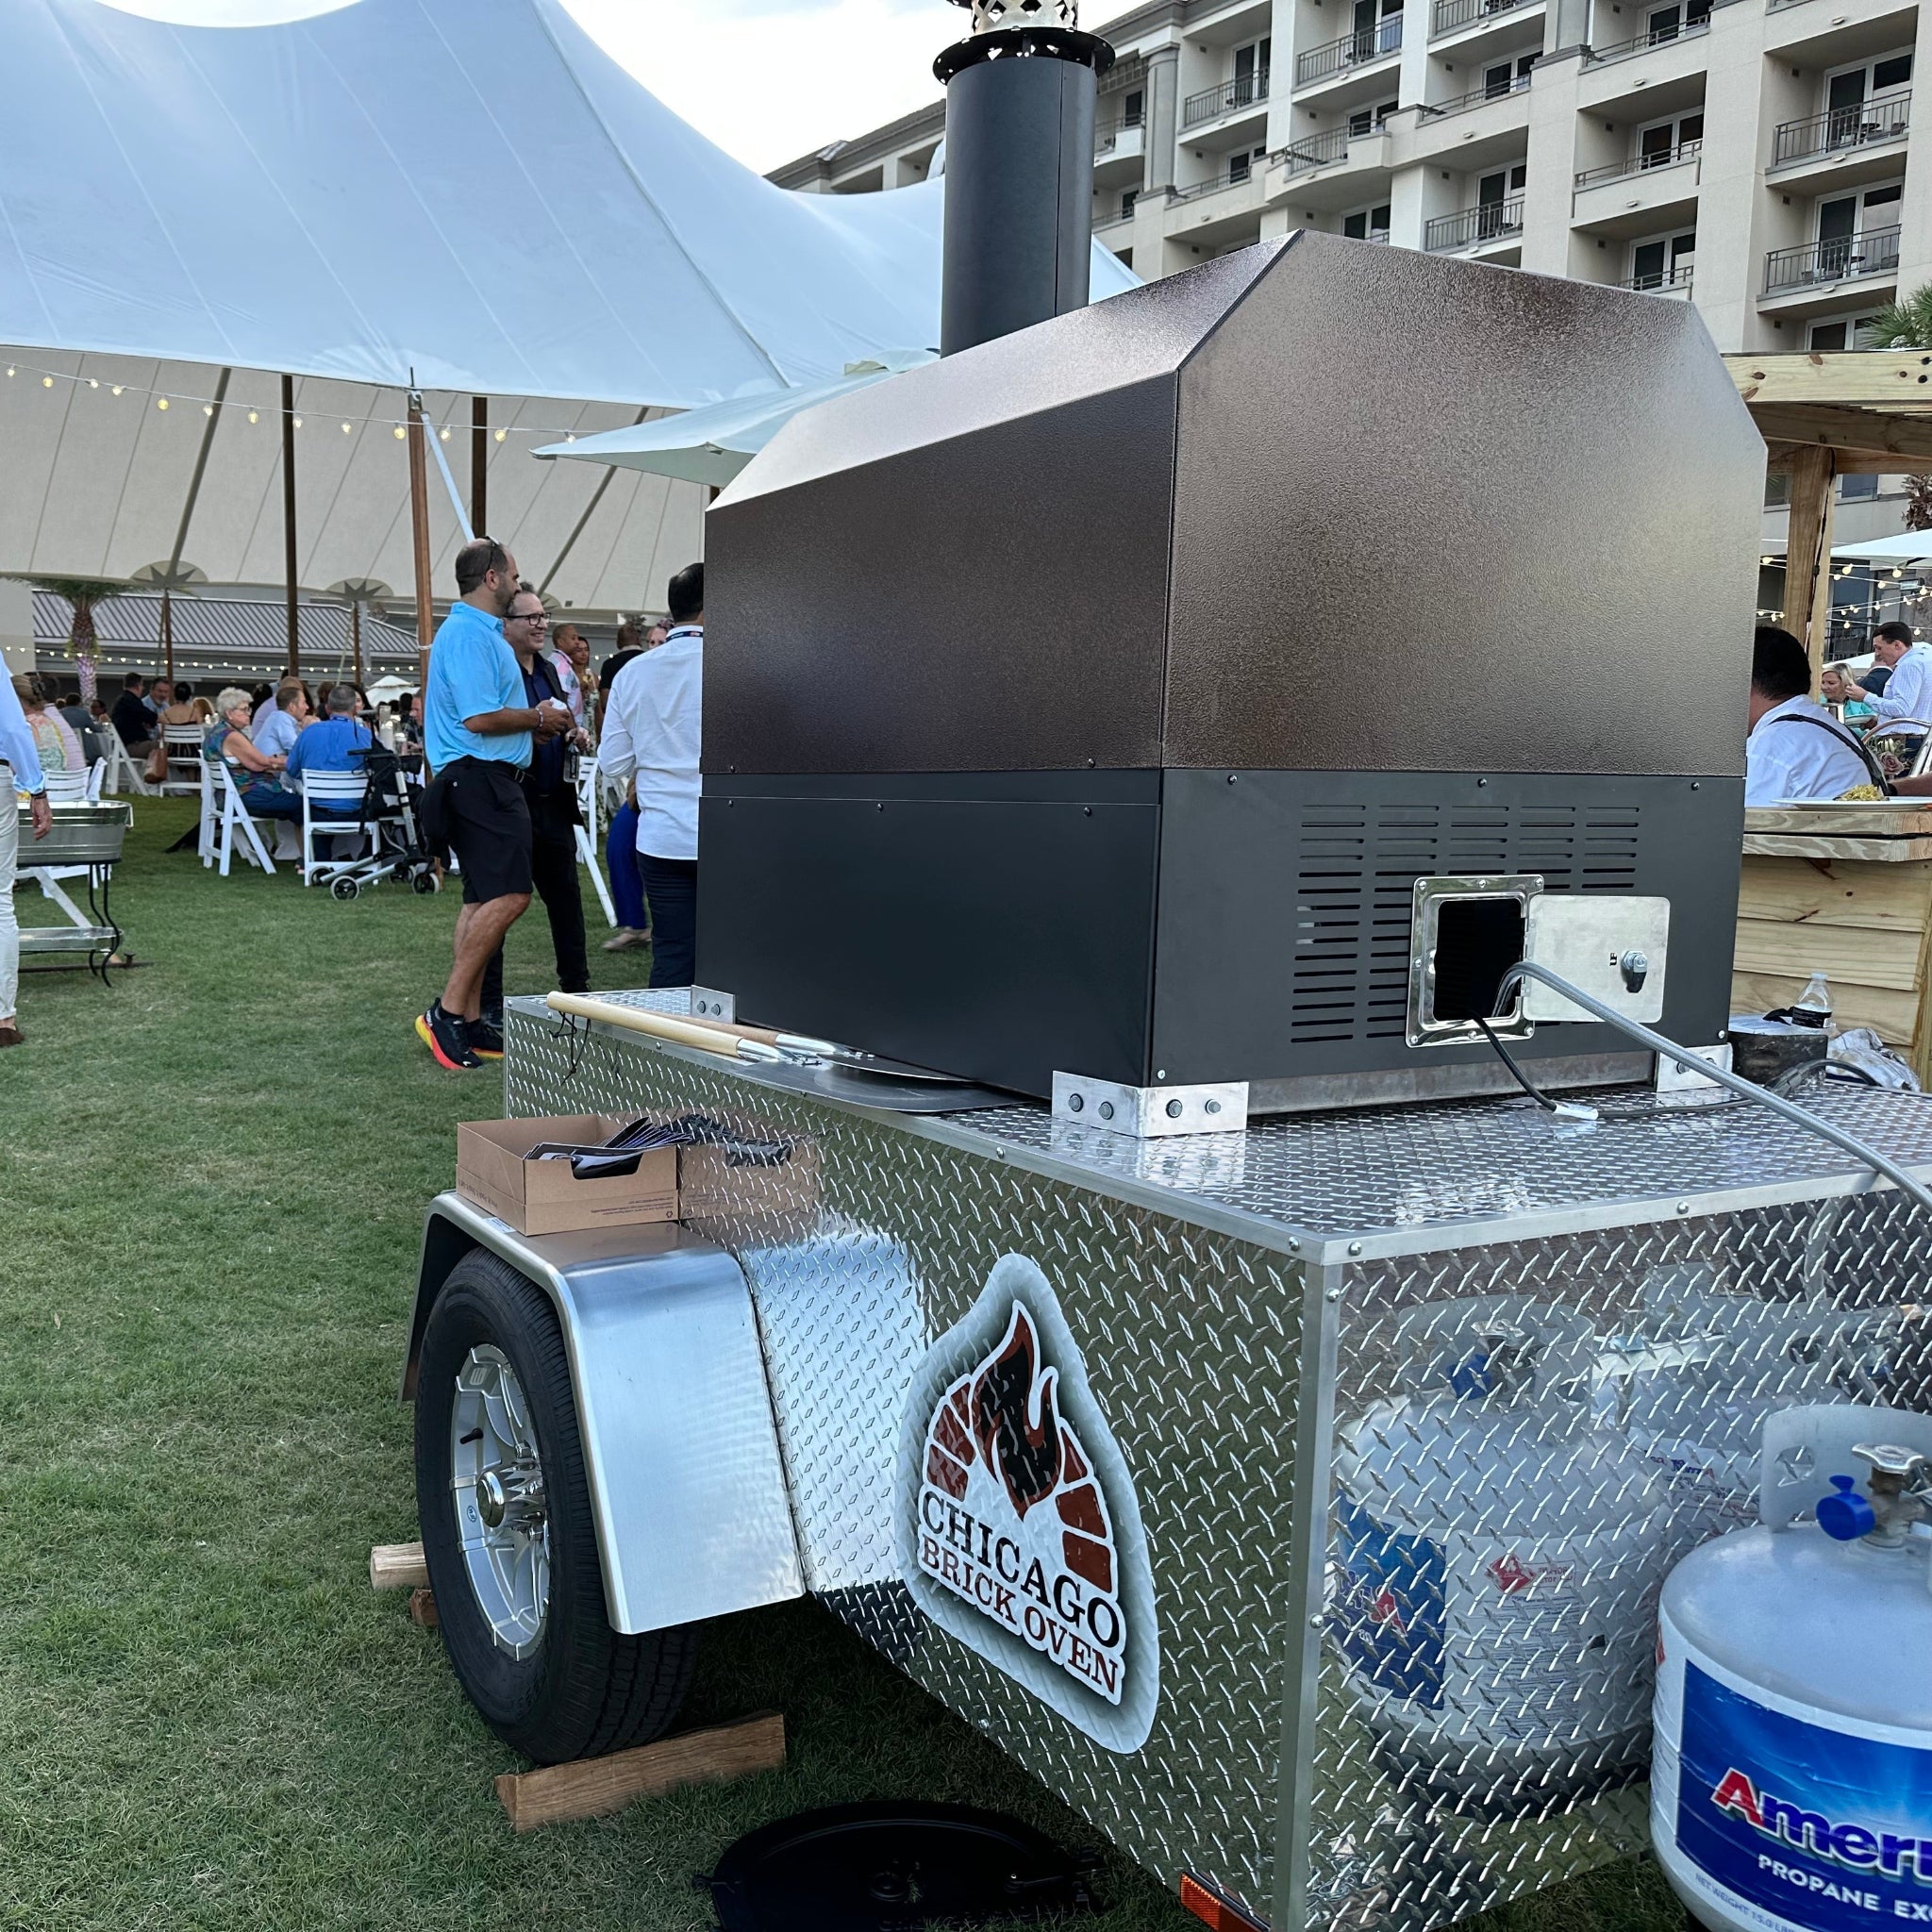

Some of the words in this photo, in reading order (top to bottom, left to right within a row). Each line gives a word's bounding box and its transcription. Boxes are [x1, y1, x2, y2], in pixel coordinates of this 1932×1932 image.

[921, 1533, 1017, 1625] BRICK
[1024, 1606, 1119, 1694] OVEN
[922, 1491, 1120, 1648] CHICAGO
[1695, 1873, 1711, 1890] NET
[1712, 1887, 1750, 1915] WEIGHT
[1757, 1853, 1881, 1912] PROPANE
[1894, 1899, 1932, 1923] EX
